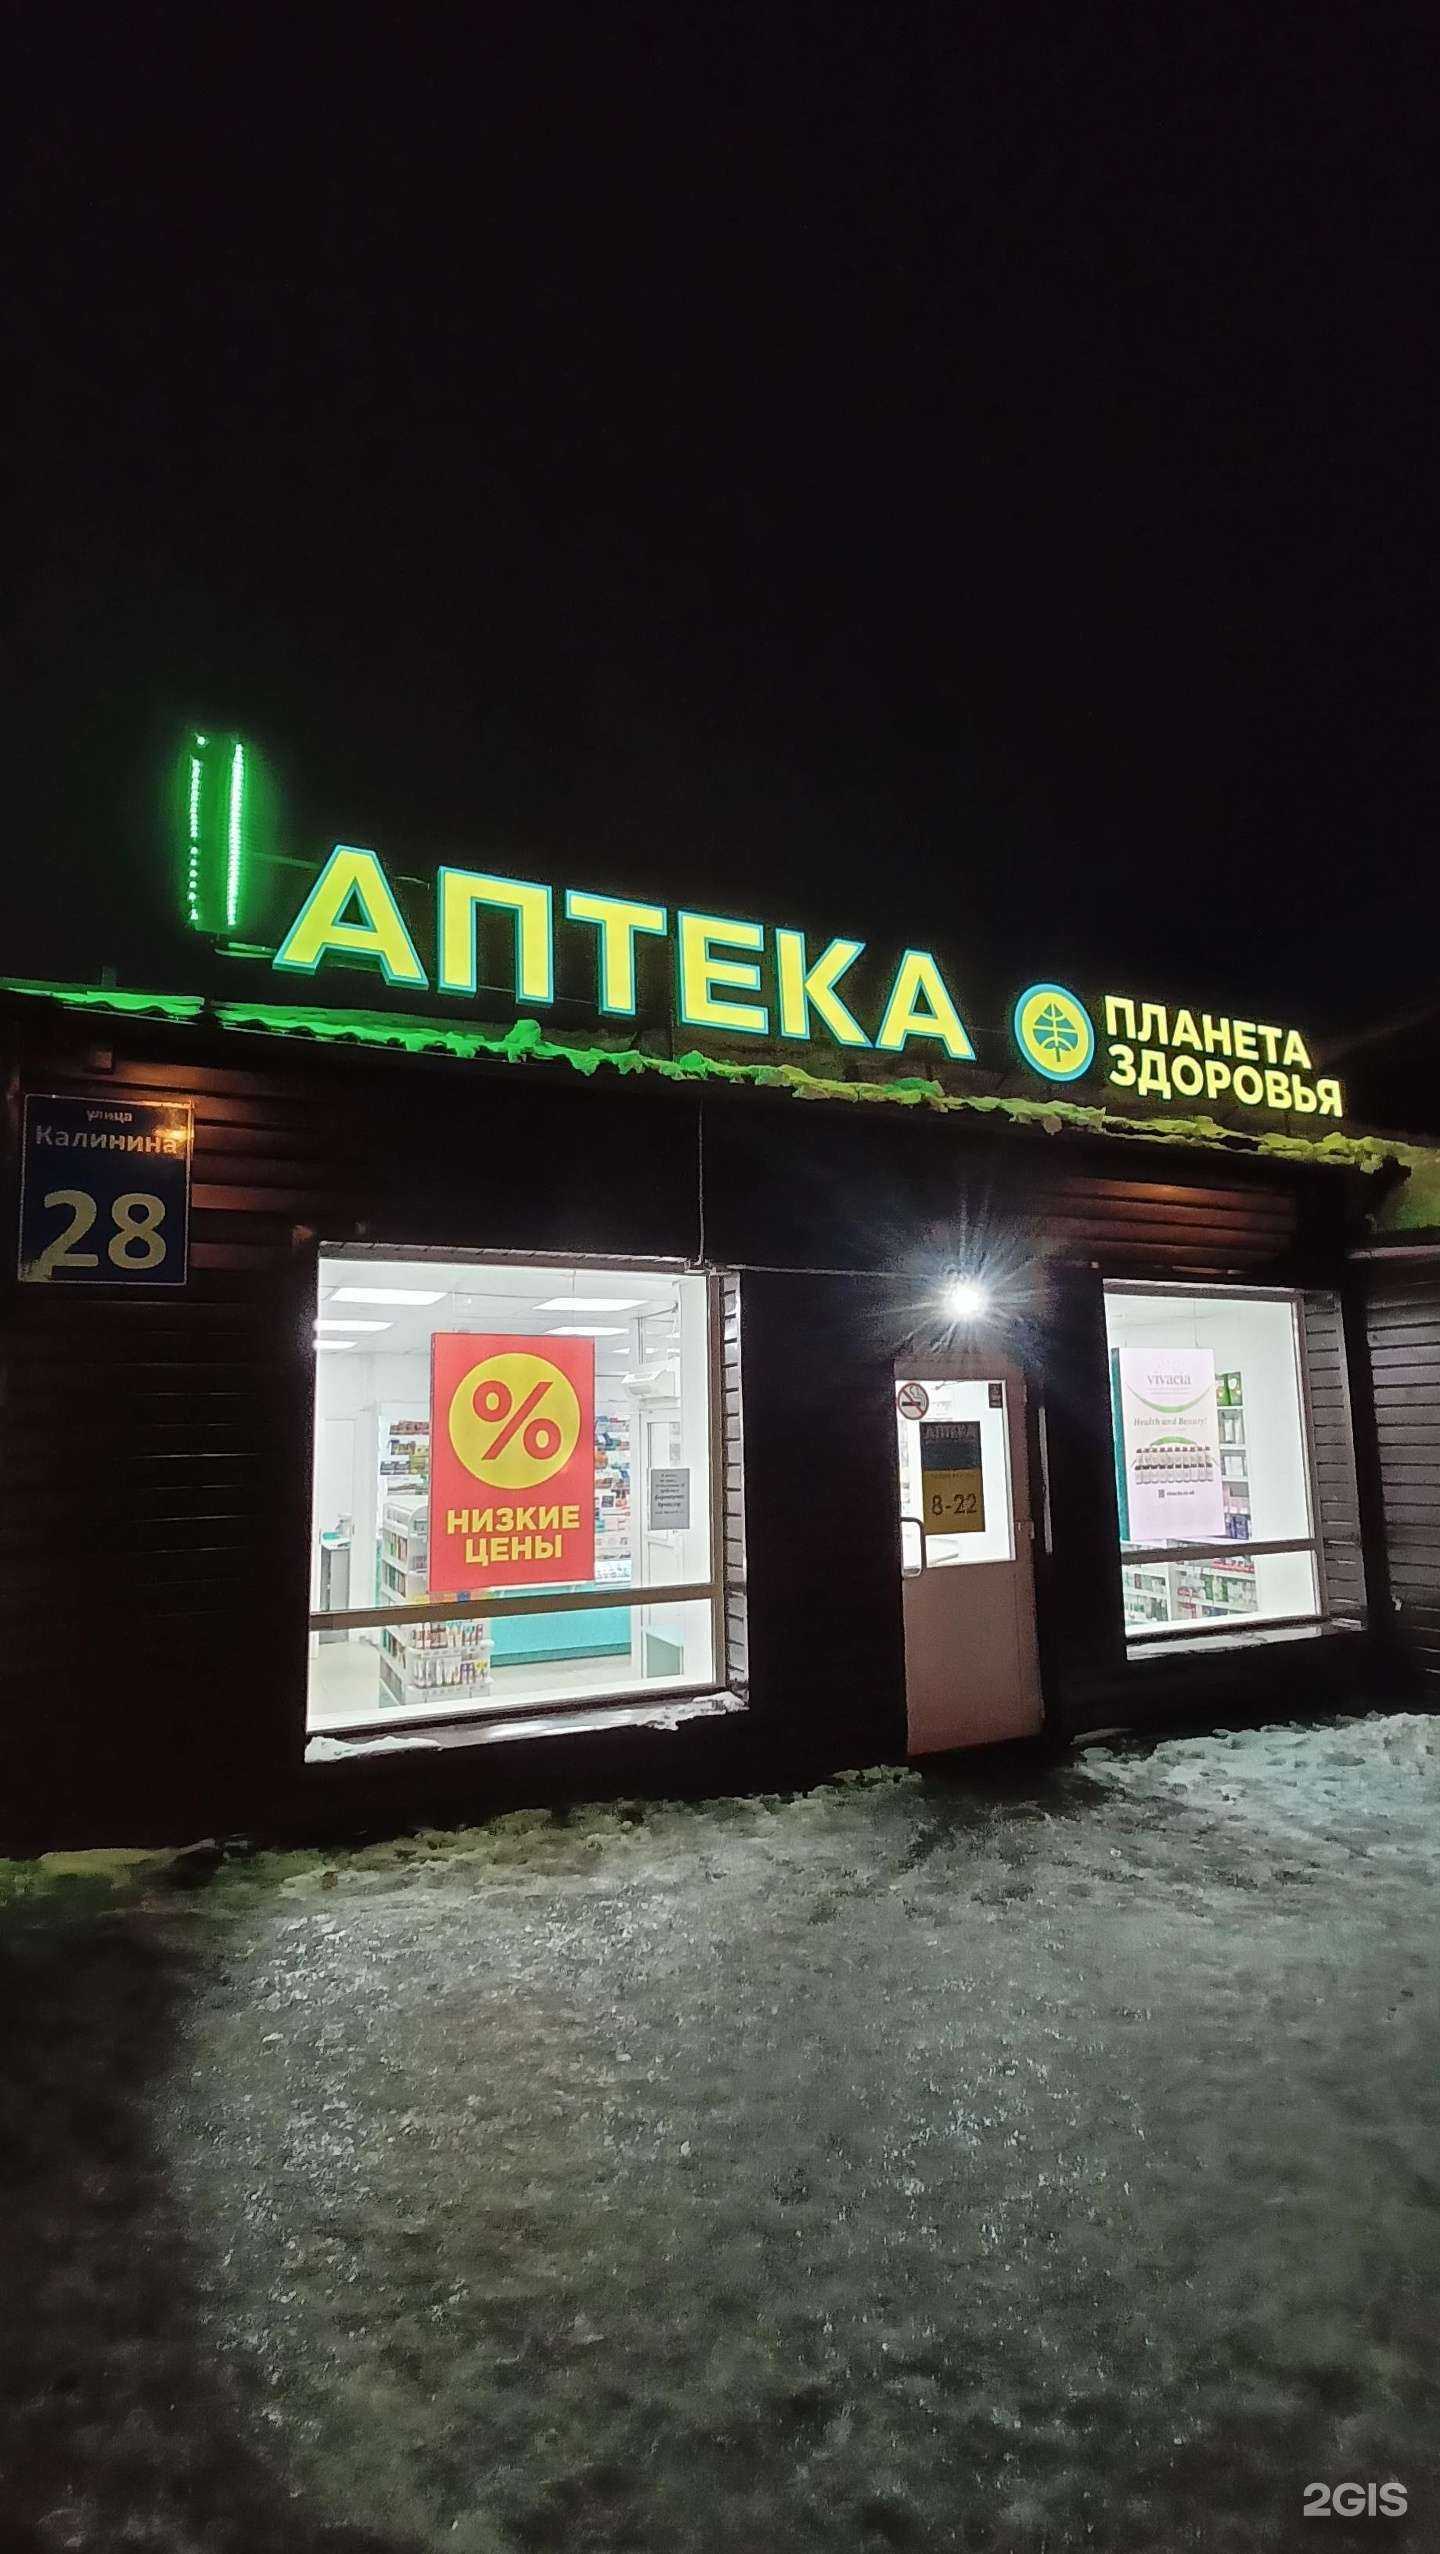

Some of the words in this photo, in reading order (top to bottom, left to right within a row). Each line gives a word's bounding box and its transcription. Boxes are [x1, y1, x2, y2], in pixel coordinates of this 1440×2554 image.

[272, 844, 977, 1061] АПТЕКА
[1104, 995, 1313, 1070] ПЛАНЕТА
[1108, 1043, 1344, 1118] ЗДОРОВЬЯ
[86, 1109, 134, 1123] улица
[35, 1124, 178, 1154] Калинина
[42, 1189, 167, 1270] 28
[1146, 1373, 1192, 1385] vivacia
[1133, 1416, 1160, 1427] Health
[932, 1492, 977, 1516] 8-22
[447, 1505, 581, 1535] НИЗКИЕ
[465, 1534, 562, 1567] ЦЕНЫ
